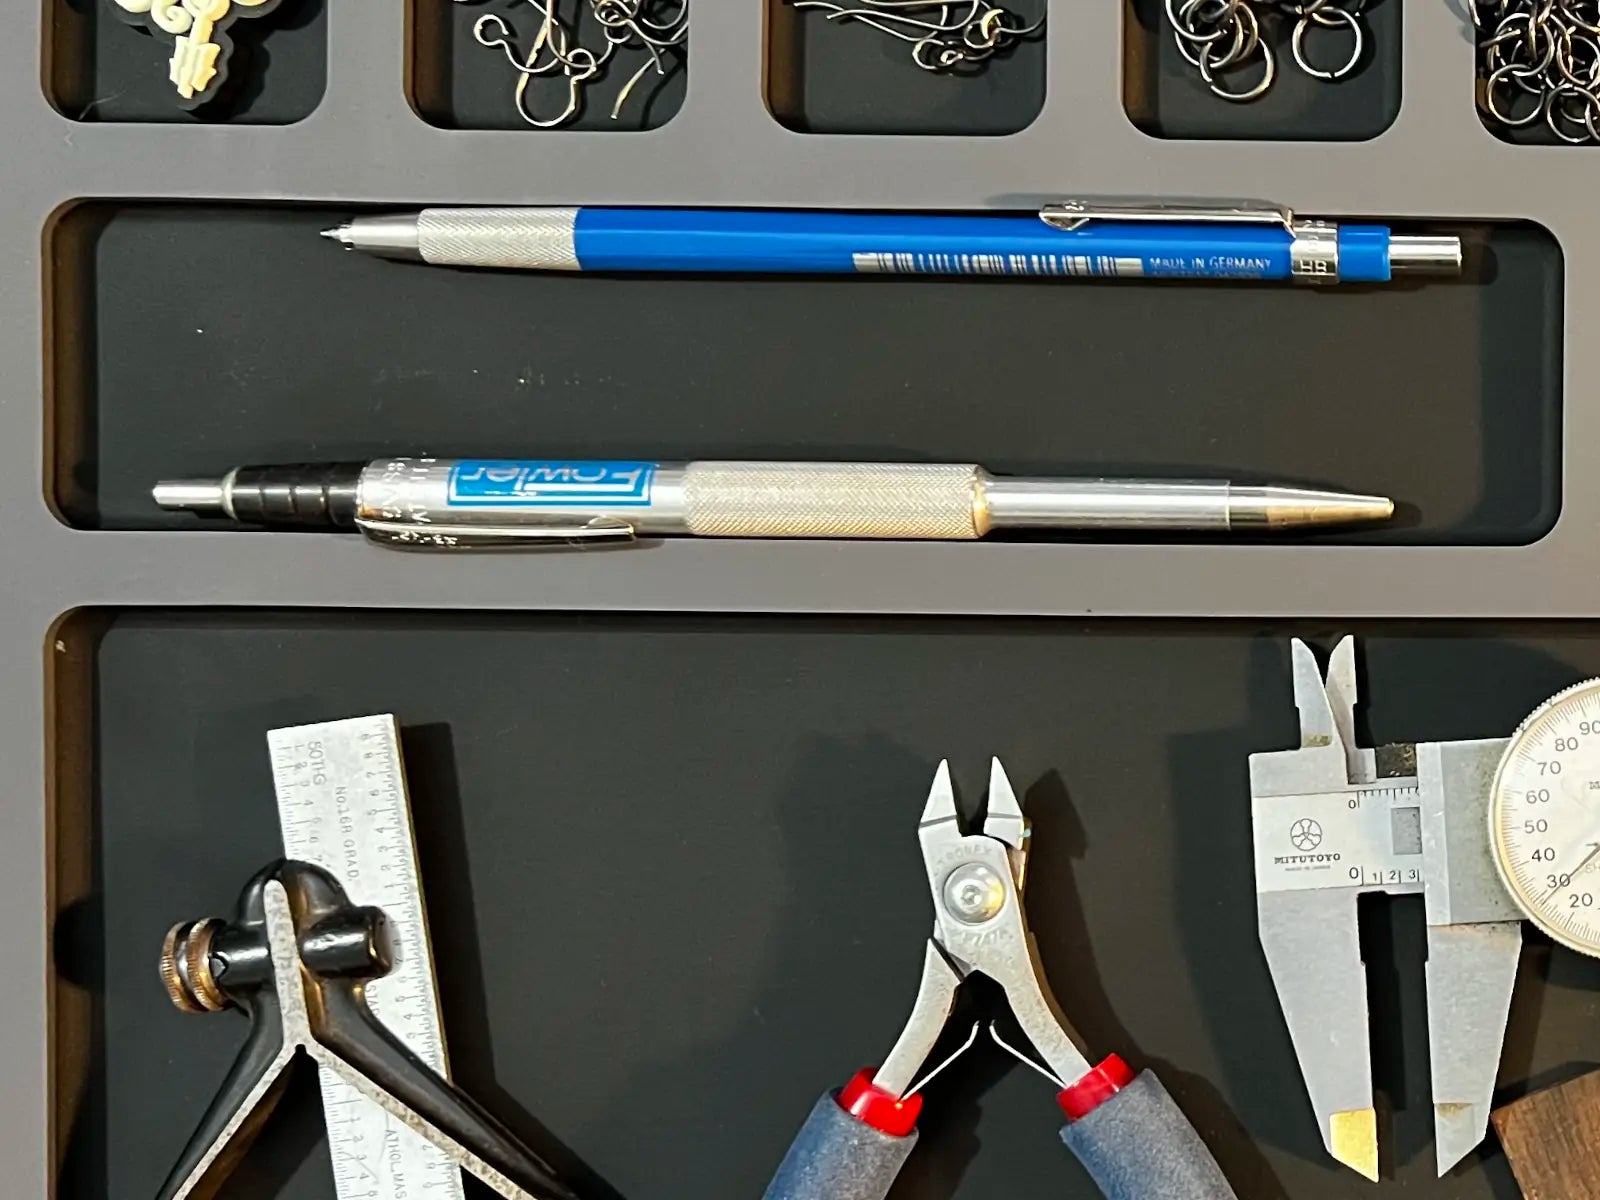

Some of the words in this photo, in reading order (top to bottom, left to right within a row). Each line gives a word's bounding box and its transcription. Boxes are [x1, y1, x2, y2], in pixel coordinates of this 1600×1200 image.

[1150, 257, 1185, 269] MADE
[1191, 257, 1205, 269] IN
[1209, 256, 1271, 269] GERMANY
[1555, 737, 1579, 752] 80
[1537, 761, 1561, 776] 70
[1348, 799, 1356, 809] 0
[1526, 789, 1550, 804] 60
[1524, 819, 1548, 834] 50
[1274, 853, 1341, 864] MITUTOYO
[1531, 847, 1555, 862] 40
[1349, 867, 1359, 879] 0
[1390, 870, 1396, 880] 2
[1409, 869, 1416, 879] 3
[1546, 873, 1571, 888] 30
[1569, 893, 1593, 908] 20
